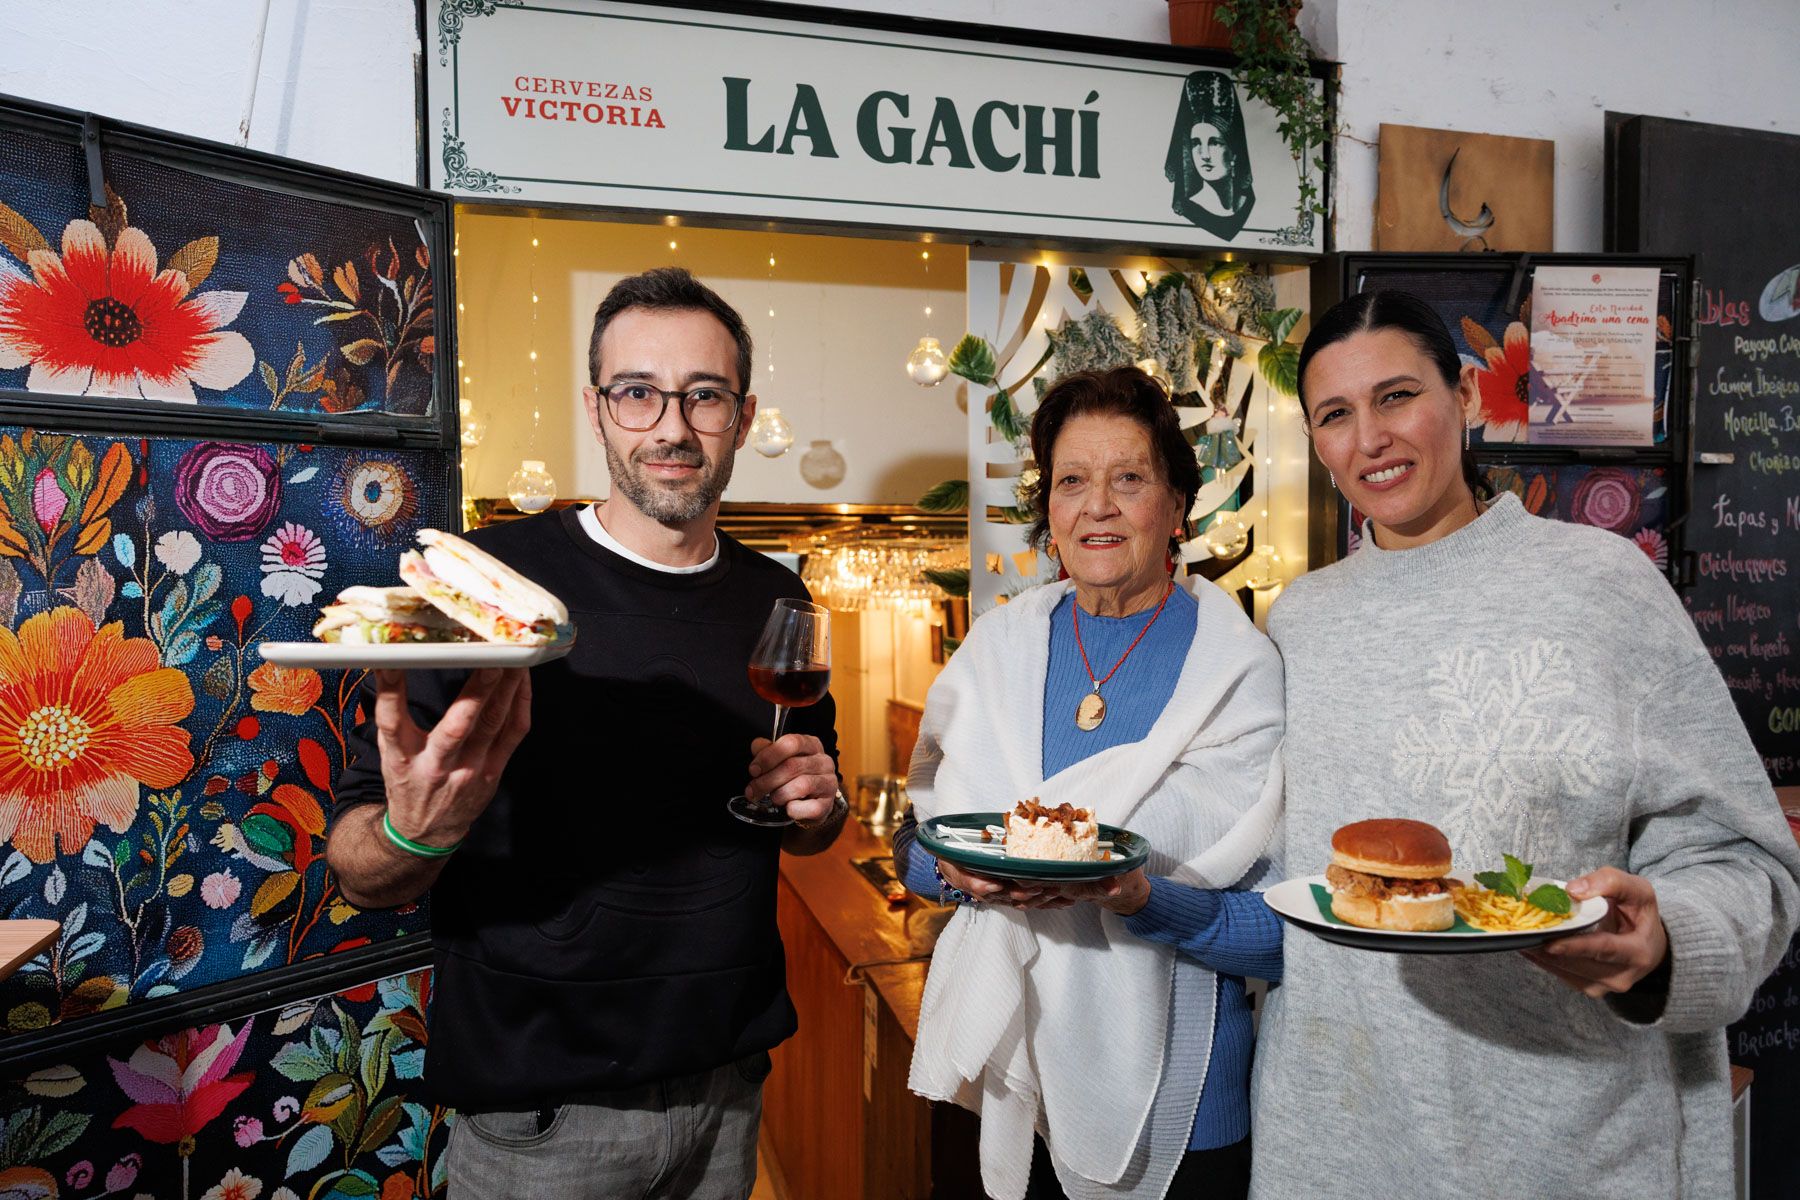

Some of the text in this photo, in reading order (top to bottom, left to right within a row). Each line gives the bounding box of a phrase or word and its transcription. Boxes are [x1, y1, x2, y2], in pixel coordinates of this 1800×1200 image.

[515, 76, 653, 101] CERVEZAS
[501, 96, 666, 129] VICTORIA
[722, 76, 1101, 179] LA GACHÍ
[1544, 310, 1649, 328] Apadrina una cena
[1697, 288, 1749, 327] blas
[1712, 493, 1800, 537] Tapas y M
